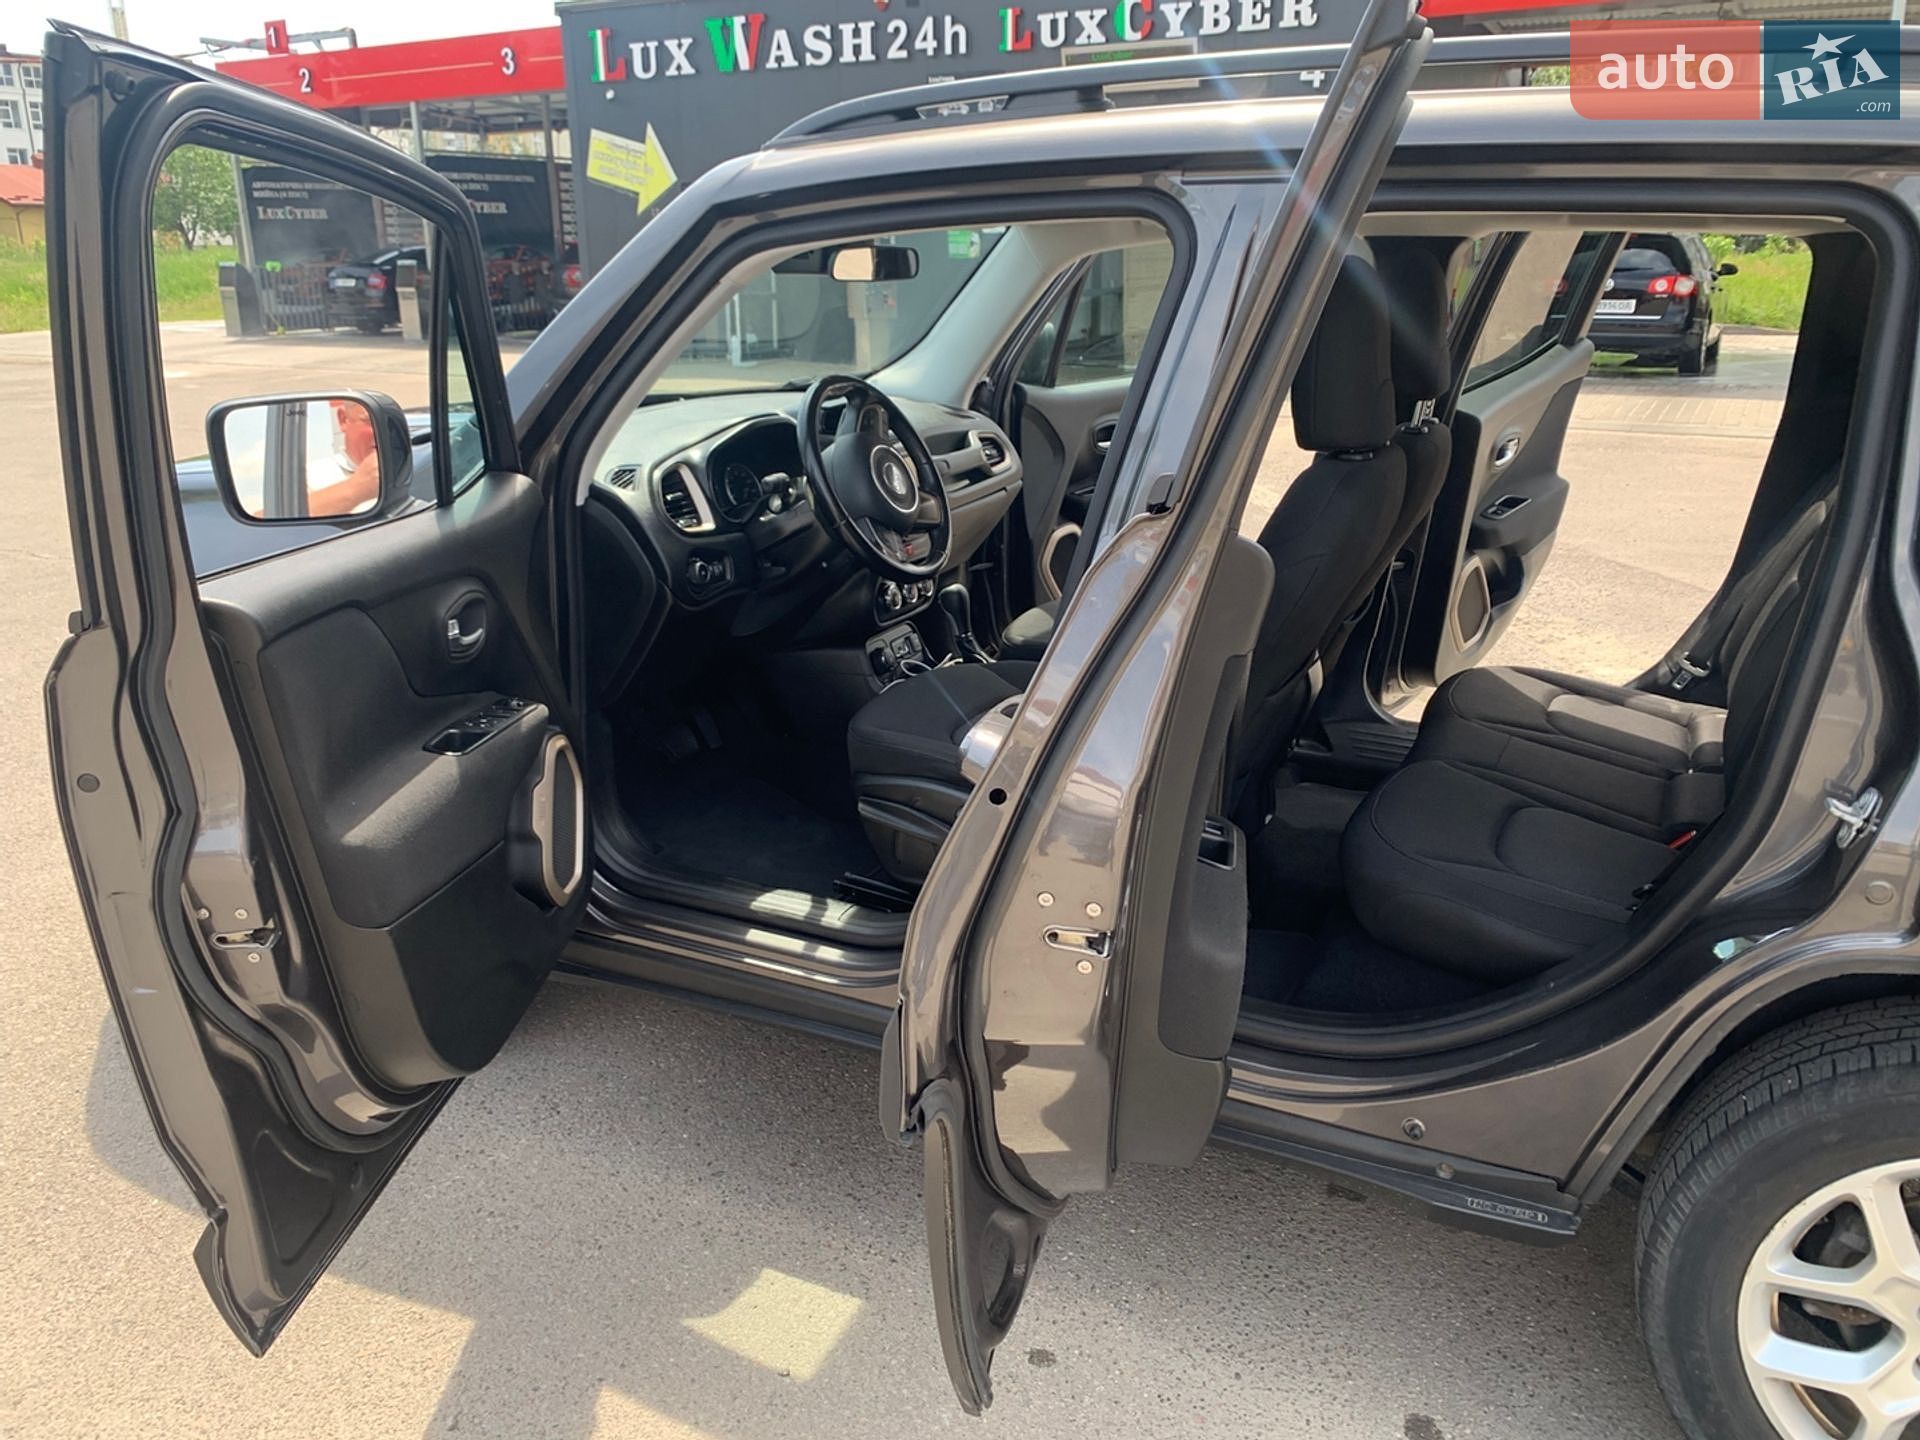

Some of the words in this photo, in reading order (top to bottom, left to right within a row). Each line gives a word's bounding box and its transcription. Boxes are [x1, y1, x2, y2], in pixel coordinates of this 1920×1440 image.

[267, 26, 279, 49] 1
[704, 13, 877, 73] WASH
[501, 47, 516, 76] 3
[299, 67, 312, 93] 2
